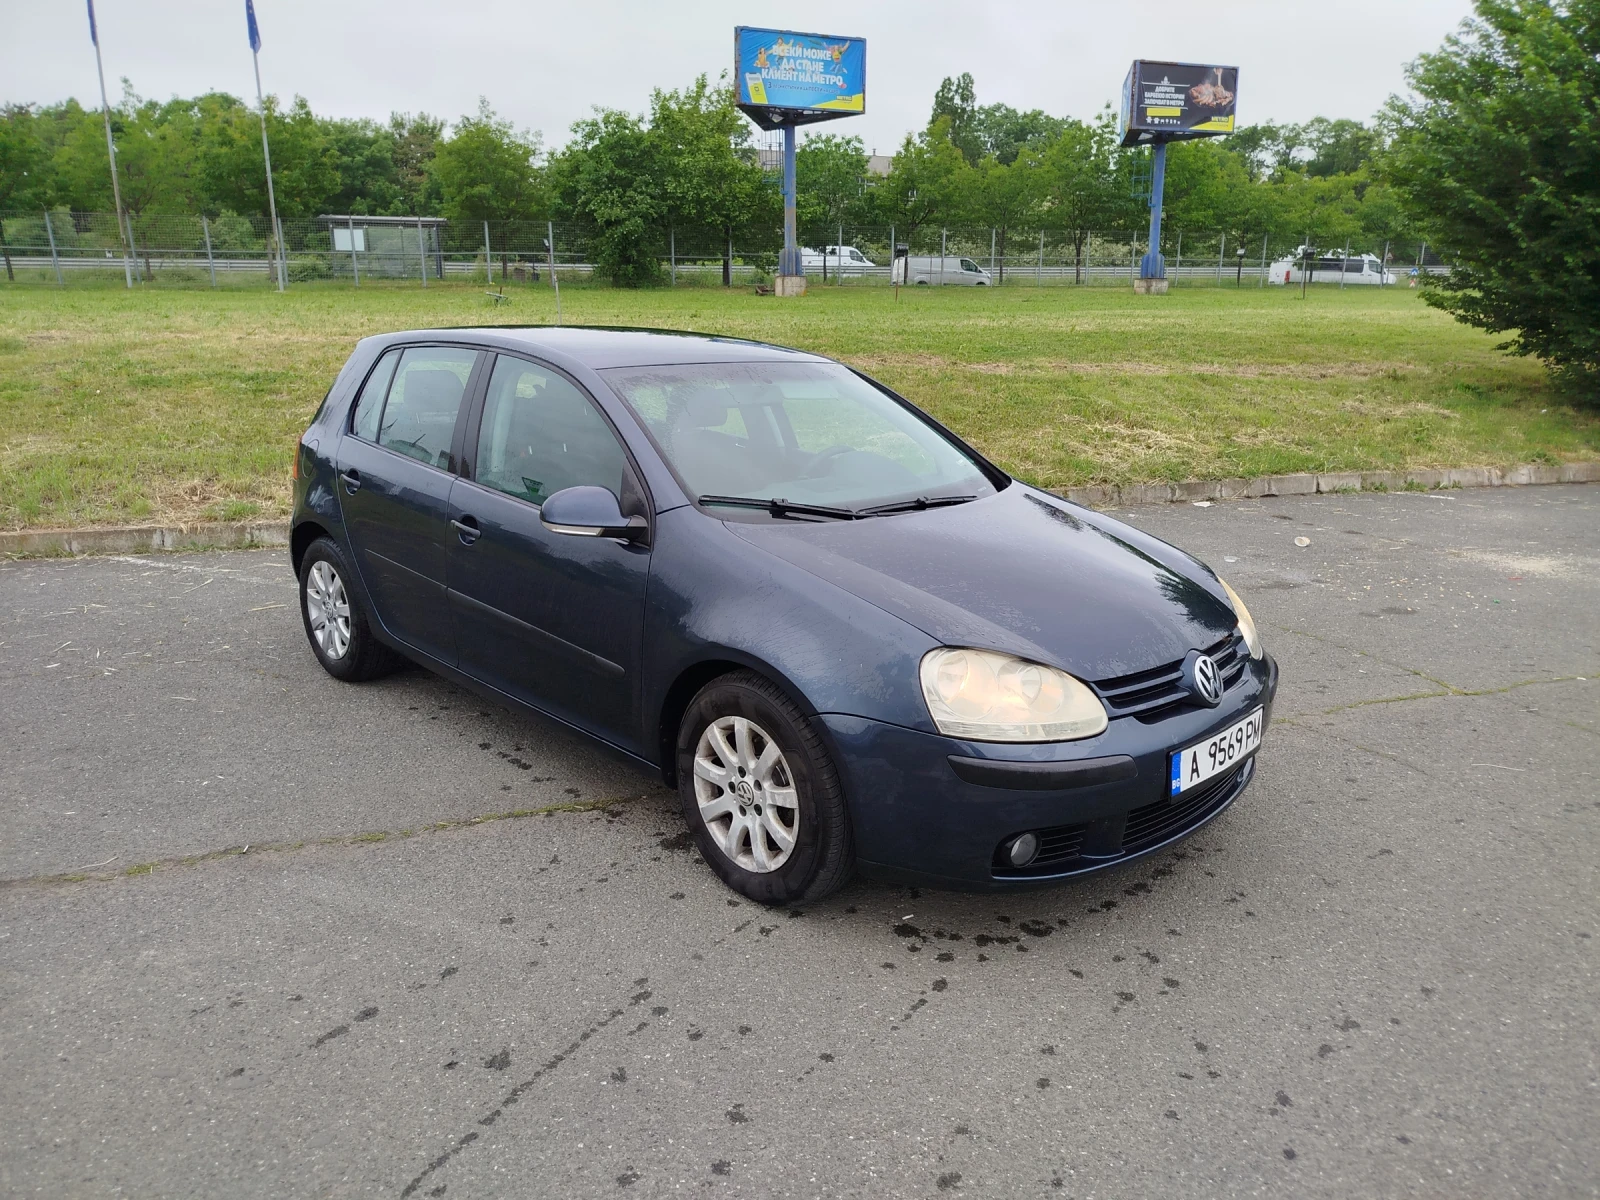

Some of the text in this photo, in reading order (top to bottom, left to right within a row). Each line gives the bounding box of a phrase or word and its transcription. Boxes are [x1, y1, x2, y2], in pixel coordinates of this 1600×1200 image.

[803, 47, 832, 61] МОЖЕ
[782, 58, 824, 72] ДА СТАНЕ
[762, 69, 843, 86] КЛИЕНТ НА МЕТРО
[1190, 714, 1261, 782] A 9569 PM
[1172, 777, 1181, 790] BG
